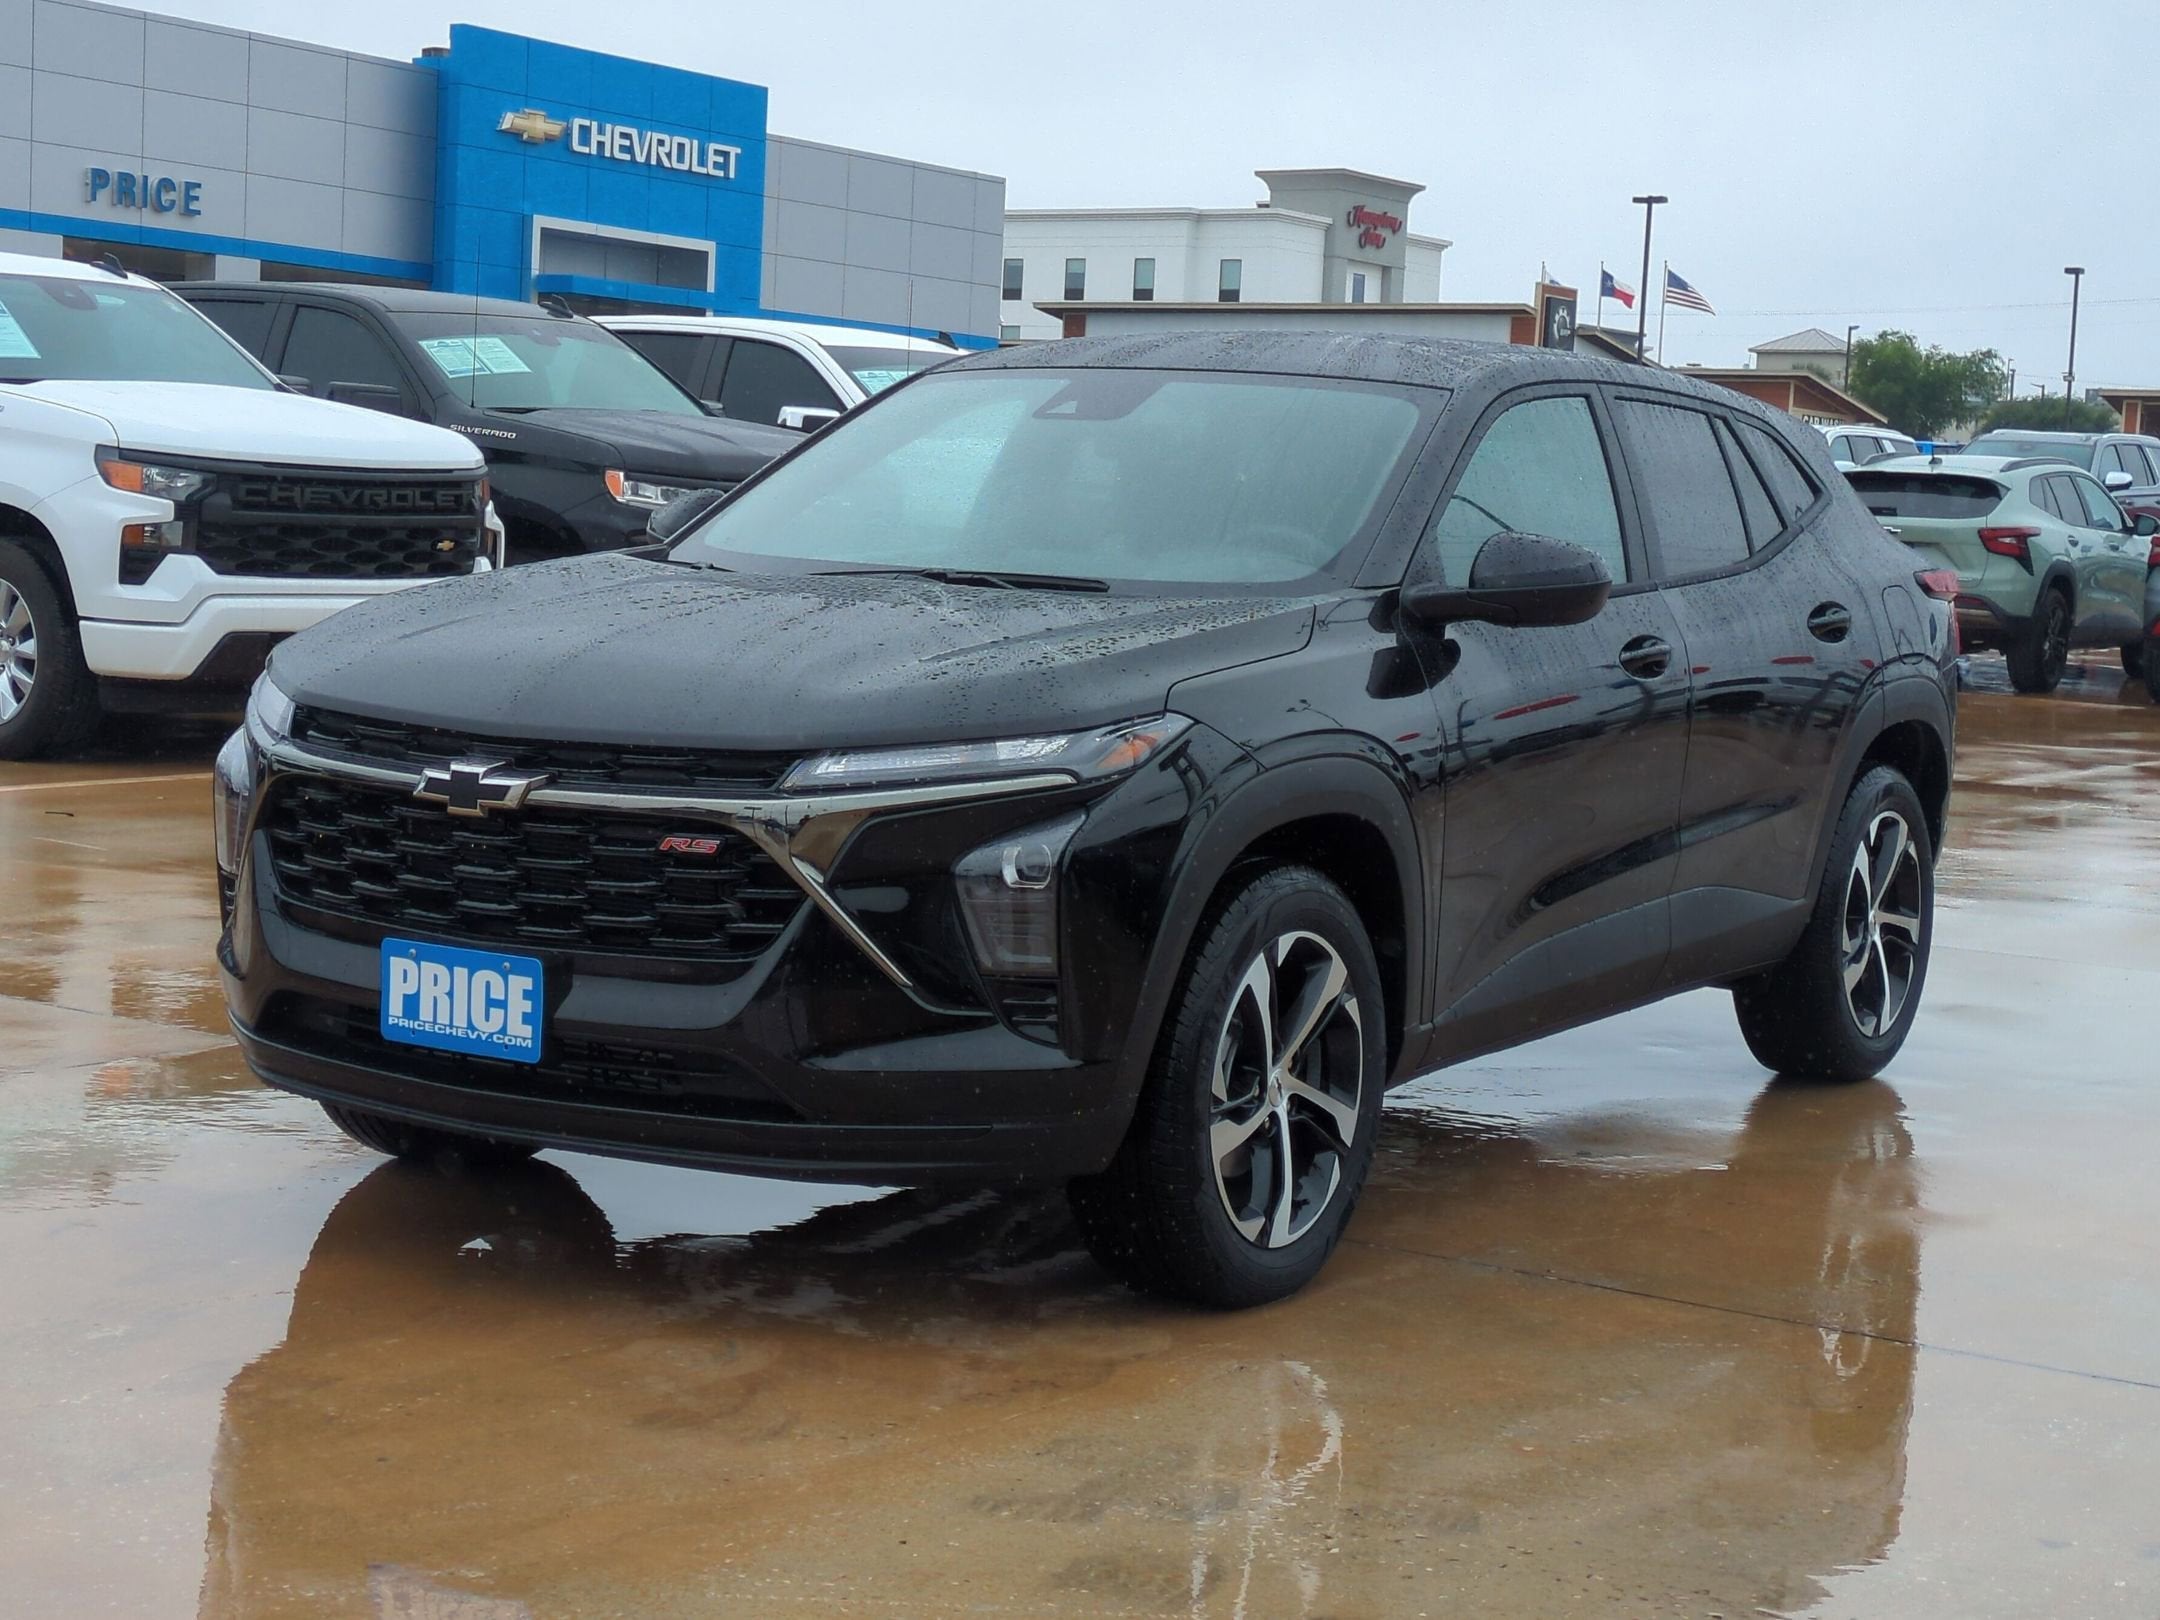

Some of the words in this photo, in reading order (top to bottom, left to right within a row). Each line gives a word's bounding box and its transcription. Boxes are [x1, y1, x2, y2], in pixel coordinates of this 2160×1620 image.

[570, 117, 741, 179] CHEVROLET
[86, 167, 202, 217] PRICE
[449, 424, 517, 439] SILVERADO
[238, 483, 474, 509] CHEVROLET
[659, 837, 720, 854] RS
[388, 956, 533, 1038] PRICE
[388, 1016, 532, 1048] PRICECHEVY.COM
